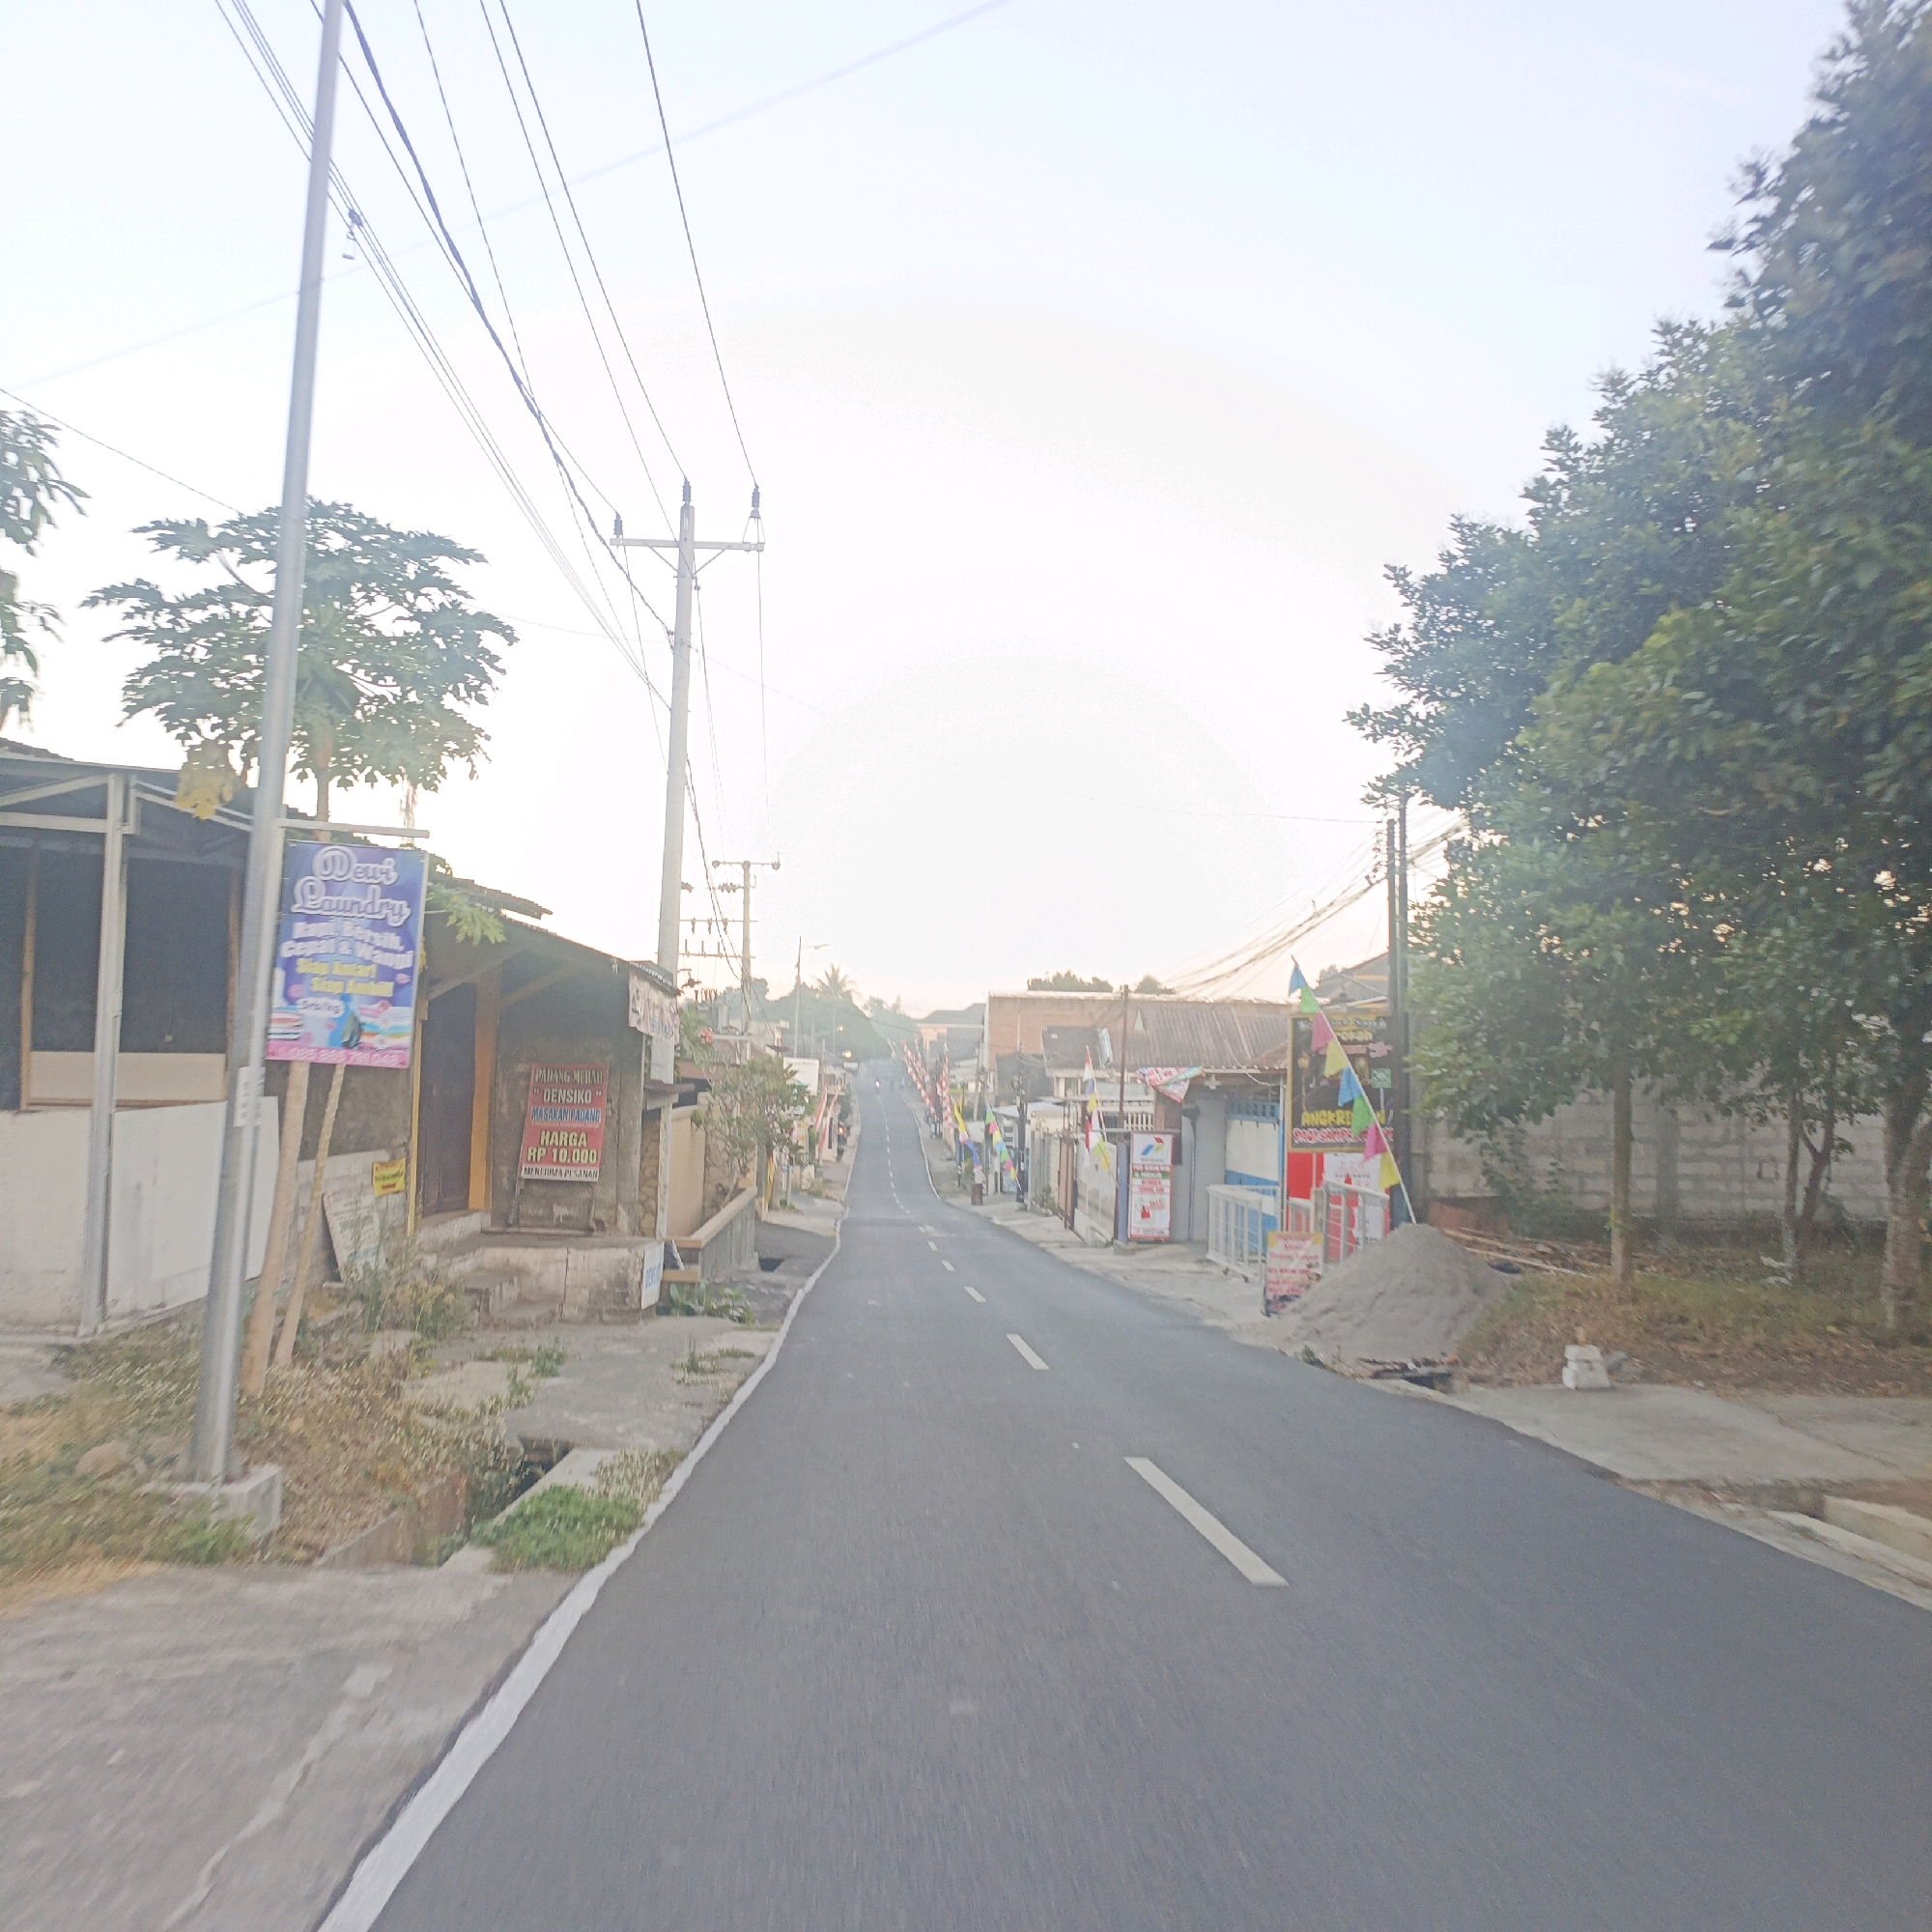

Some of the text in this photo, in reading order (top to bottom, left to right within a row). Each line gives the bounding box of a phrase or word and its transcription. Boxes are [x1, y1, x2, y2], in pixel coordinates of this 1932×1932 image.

[312, 844, 399, 885] Dewi
[290, 875, 412, 927] Laundry
[280, 939, 414, 969] Cepat & Wangi
[534, 1067, 603, 1085] PADANG MURAH
[543, 1087, 593, 1104] DENSIKO
[531, 1106, 601, 1123] MASAKAN PADANG
[540, 1129, 588, 1149] HARGA
[526, 1146, 598, 1165] RP 10.000
